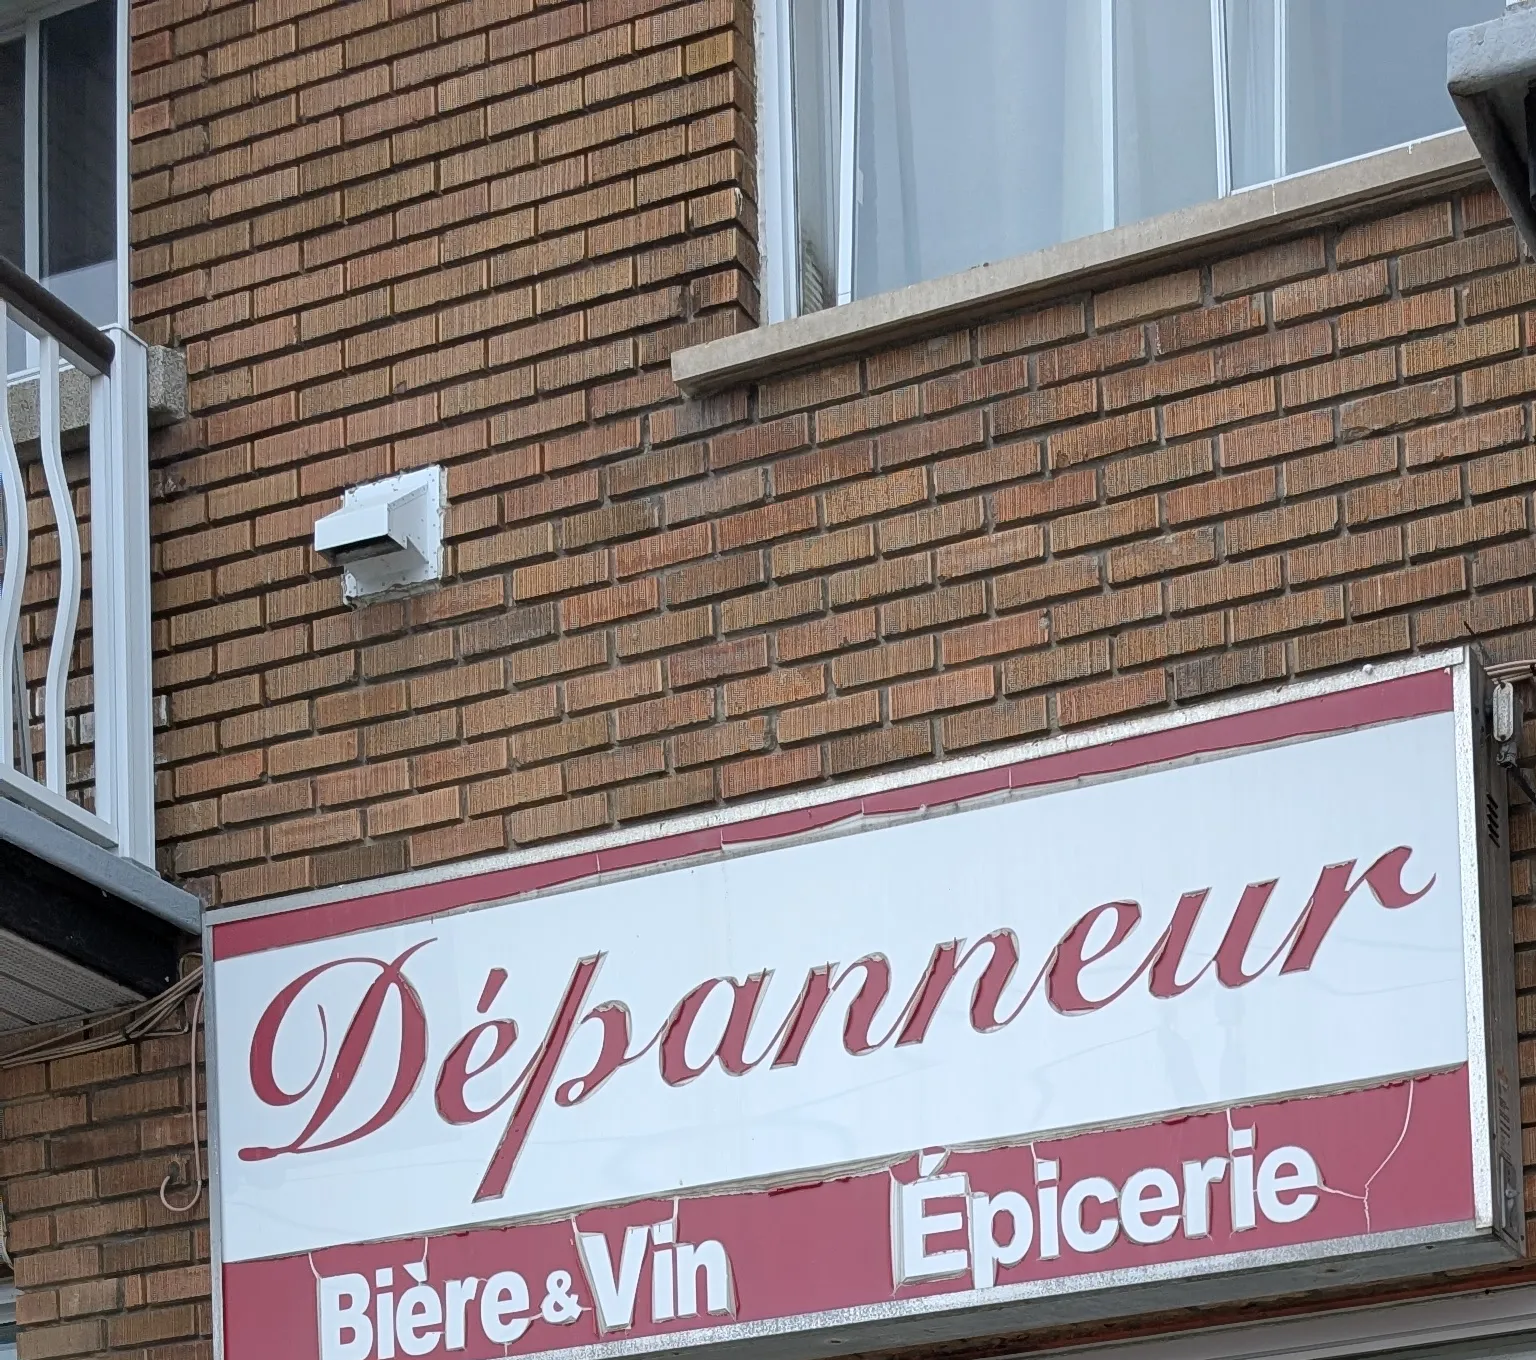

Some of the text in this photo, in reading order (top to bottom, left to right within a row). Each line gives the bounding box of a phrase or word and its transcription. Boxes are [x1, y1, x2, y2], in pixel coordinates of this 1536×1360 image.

[237, 845, 1437, 1204] Dépanneur
[580, 1222, 731, 1330] Vin
[902, 1127, 1319, 1289] Épicerie
